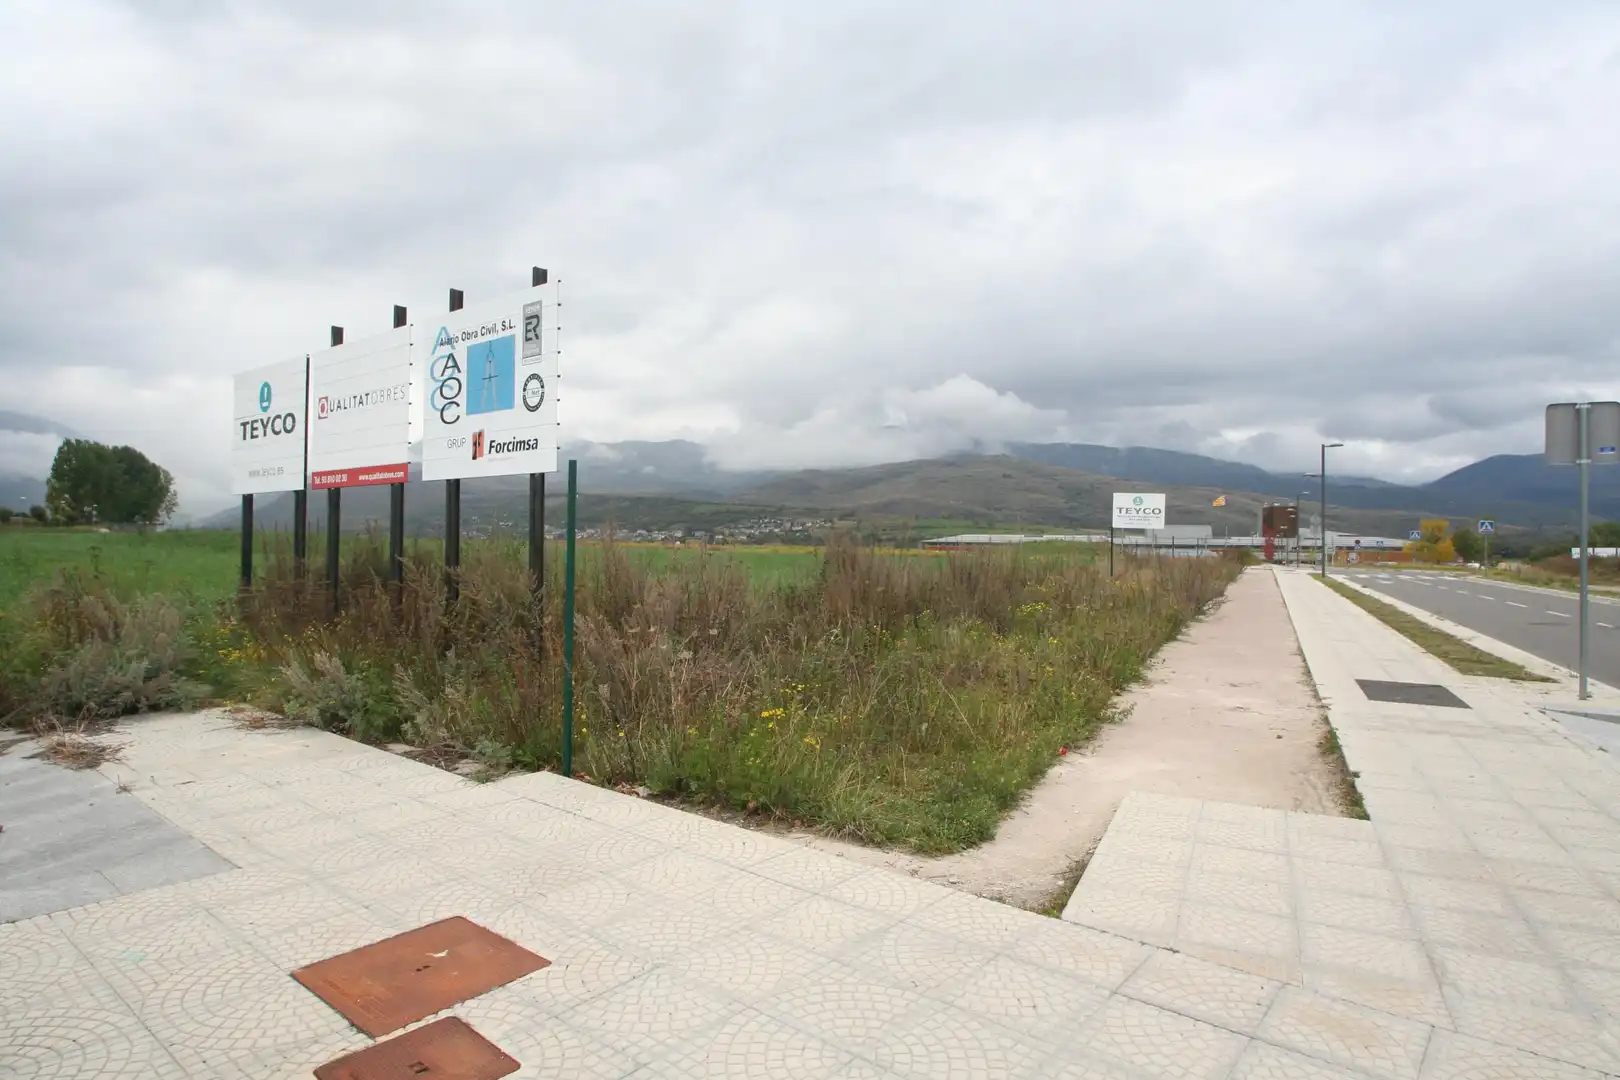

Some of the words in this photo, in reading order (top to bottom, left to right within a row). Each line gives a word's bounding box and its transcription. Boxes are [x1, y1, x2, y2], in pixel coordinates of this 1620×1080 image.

[461, 330, 478, 341] Obra
[480, 322, 499, 336] Civil,
[501, 319, 516, 331] S.L.
[240, 412, 296, 441] TEYCO
[447, 437, 467, 449] GRUP
[488, 436, 539, 455] Forcimsa
[1116, 507, 1162, 515] TEYCO
